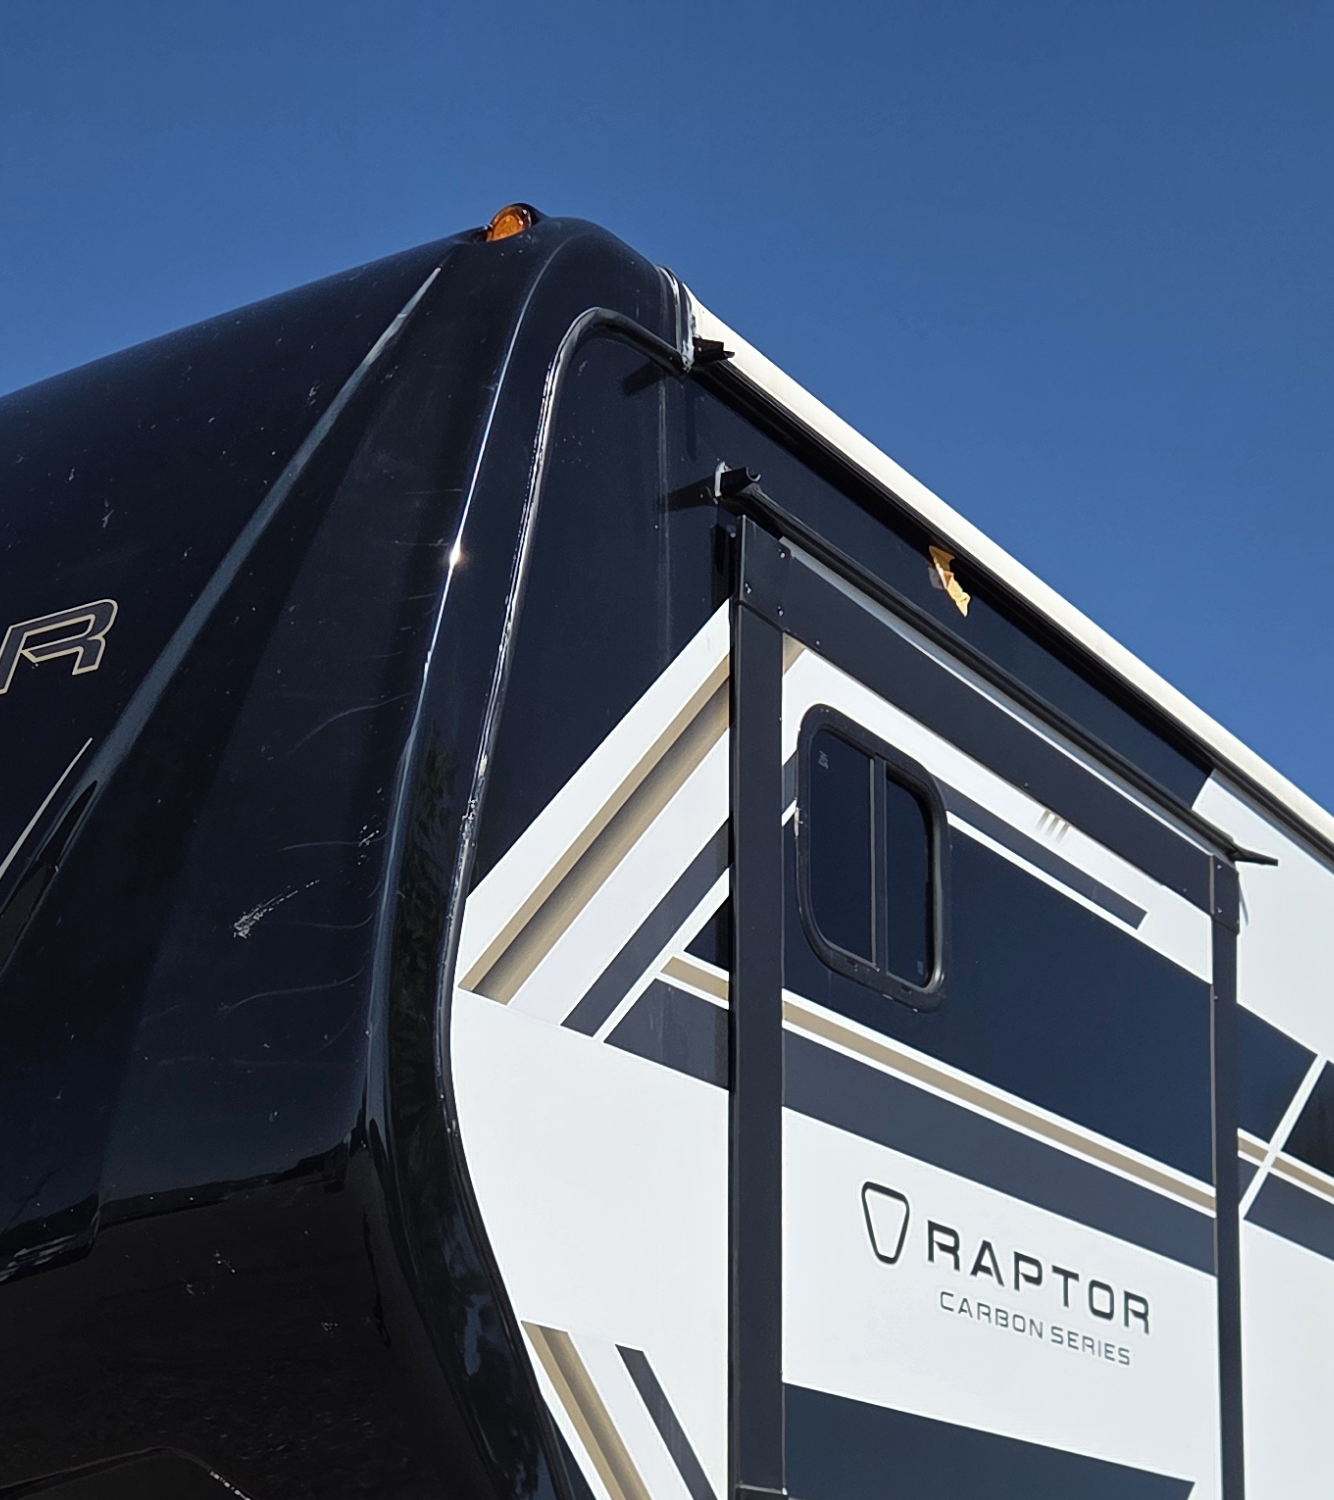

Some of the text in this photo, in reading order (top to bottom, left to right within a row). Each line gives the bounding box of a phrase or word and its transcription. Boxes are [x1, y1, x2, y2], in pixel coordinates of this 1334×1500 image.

[927, 1219, 1150, 1335] RAPTOR
[940, 1290, 1131, 1366] CARBON SERIES
